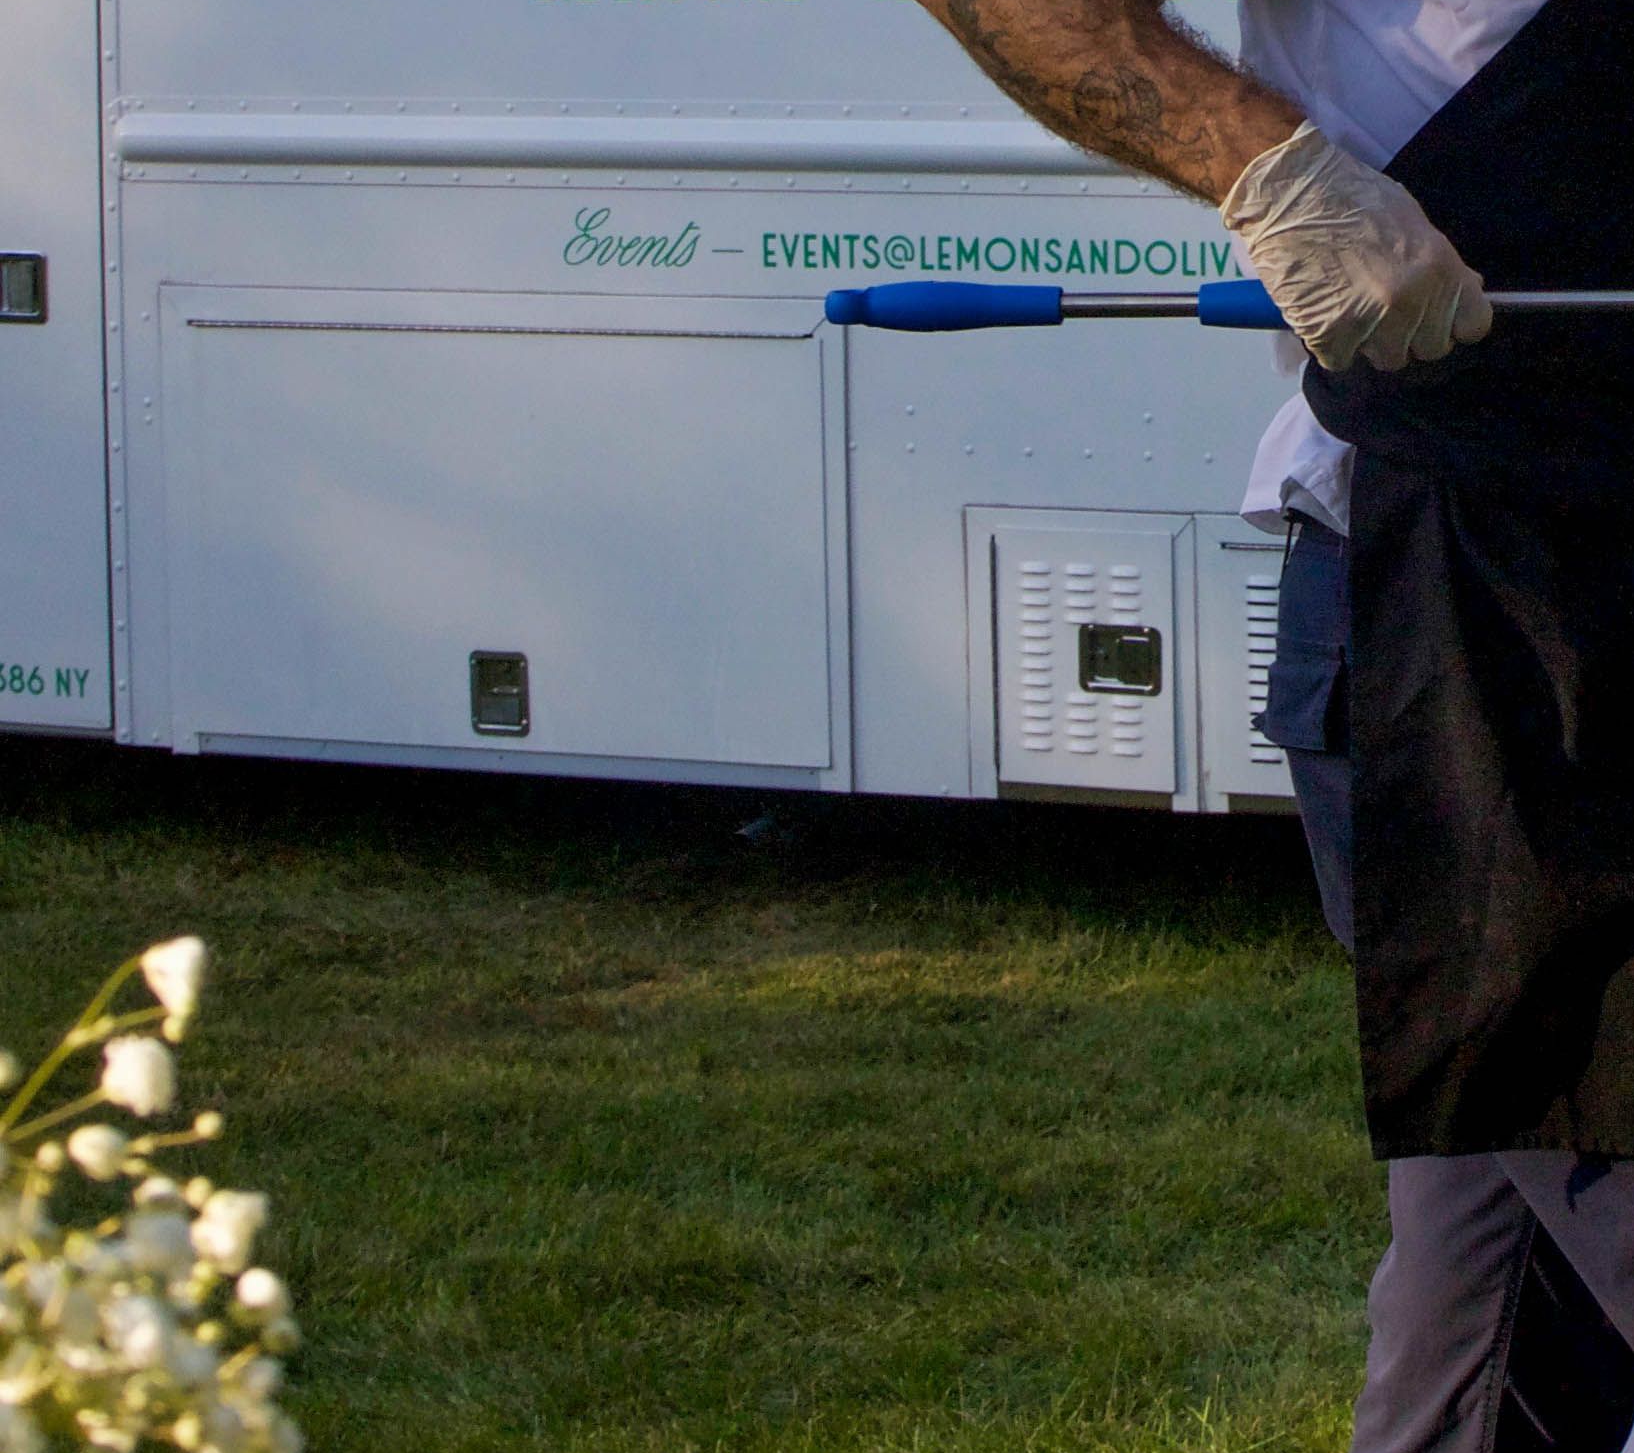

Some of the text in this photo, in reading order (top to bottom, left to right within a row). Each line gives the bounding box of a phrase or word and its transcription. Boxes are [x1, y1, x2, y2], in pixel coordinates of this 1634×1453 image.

[563, 207, 1243, 278] Events EVENTS@LEMONSANDOLIV
[55, 667, 90, 698] NY
